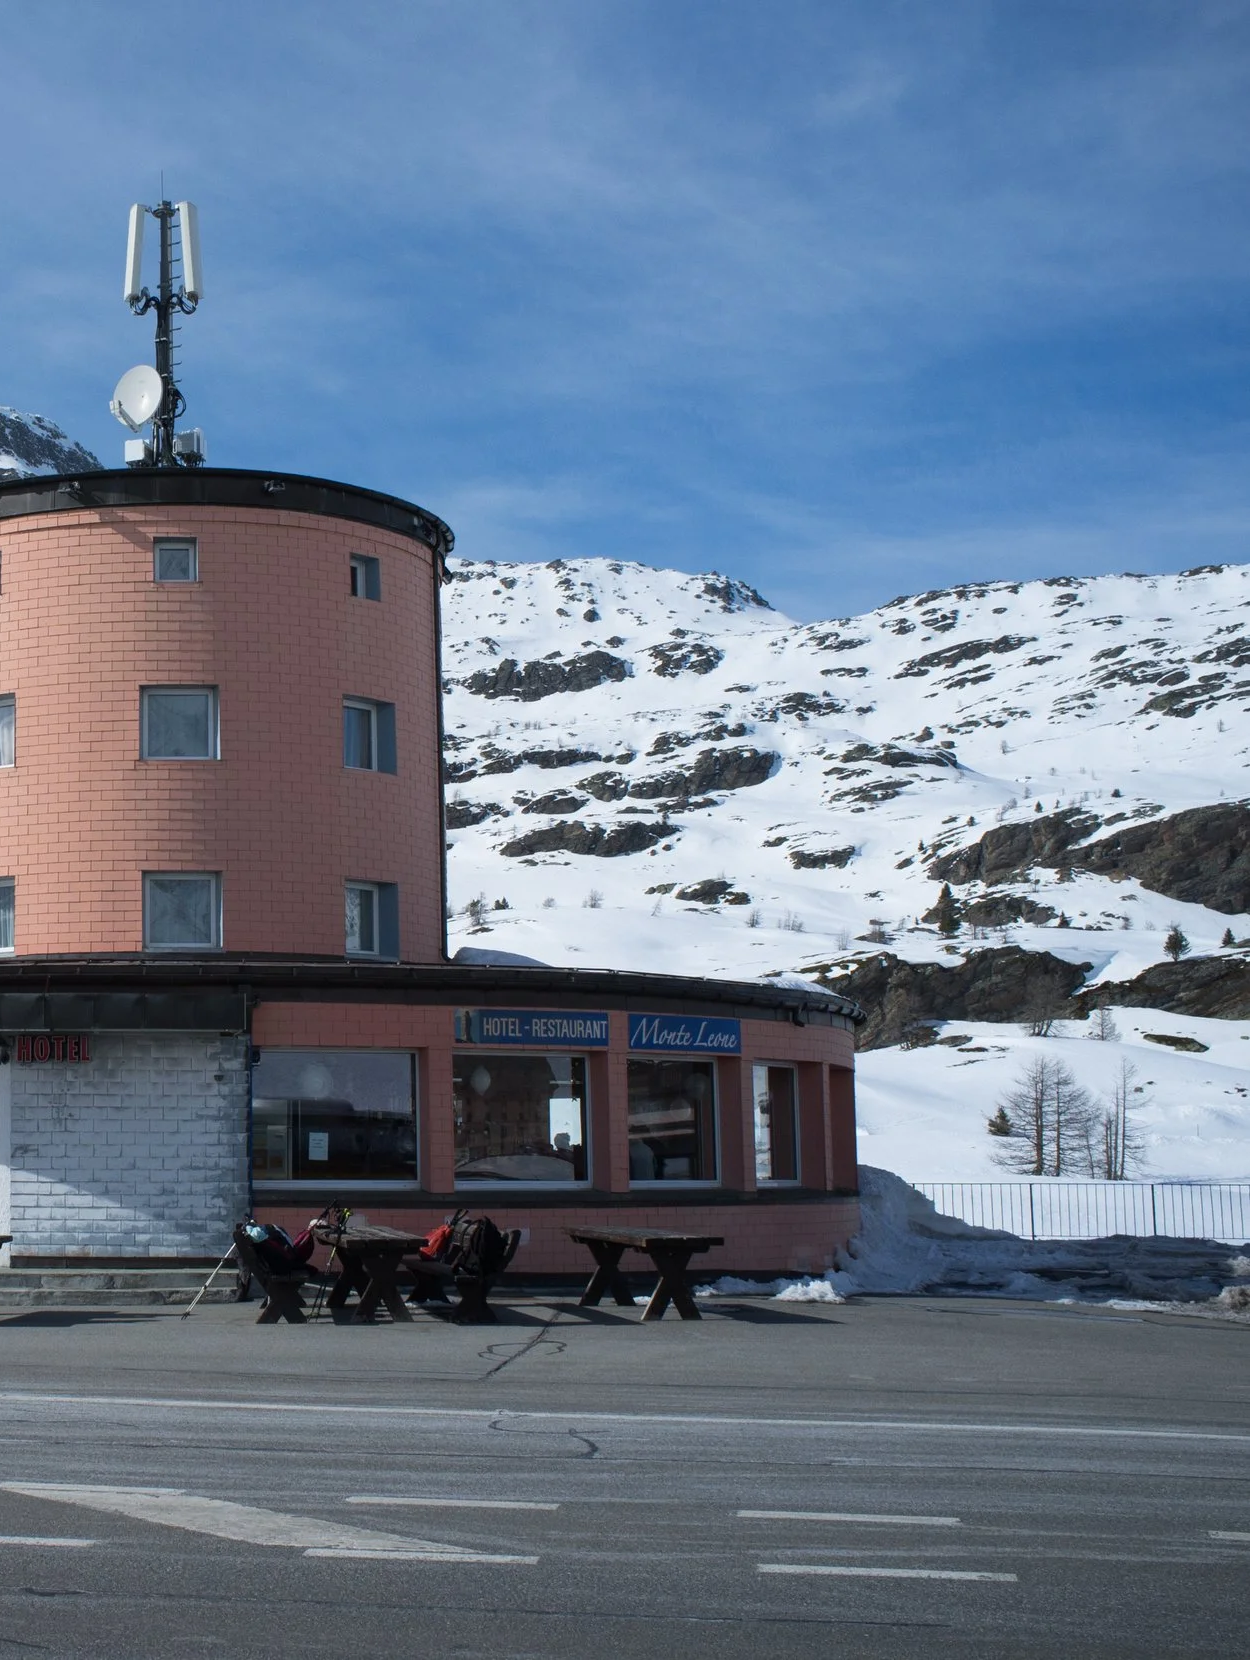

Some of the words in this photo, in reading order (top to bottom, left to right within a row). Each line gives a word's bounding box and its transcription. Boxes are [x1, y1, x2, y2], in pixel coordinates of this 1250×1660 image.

[483, 1017, 523, 1038] HOTEL
[532, 1018, 607, 1040] RESTAURANT
[630, 1016, 692, 1047] Monte
[693, 1021, 738, 1048] Leone
[16, 1035, 90, 1063] HOTEL
